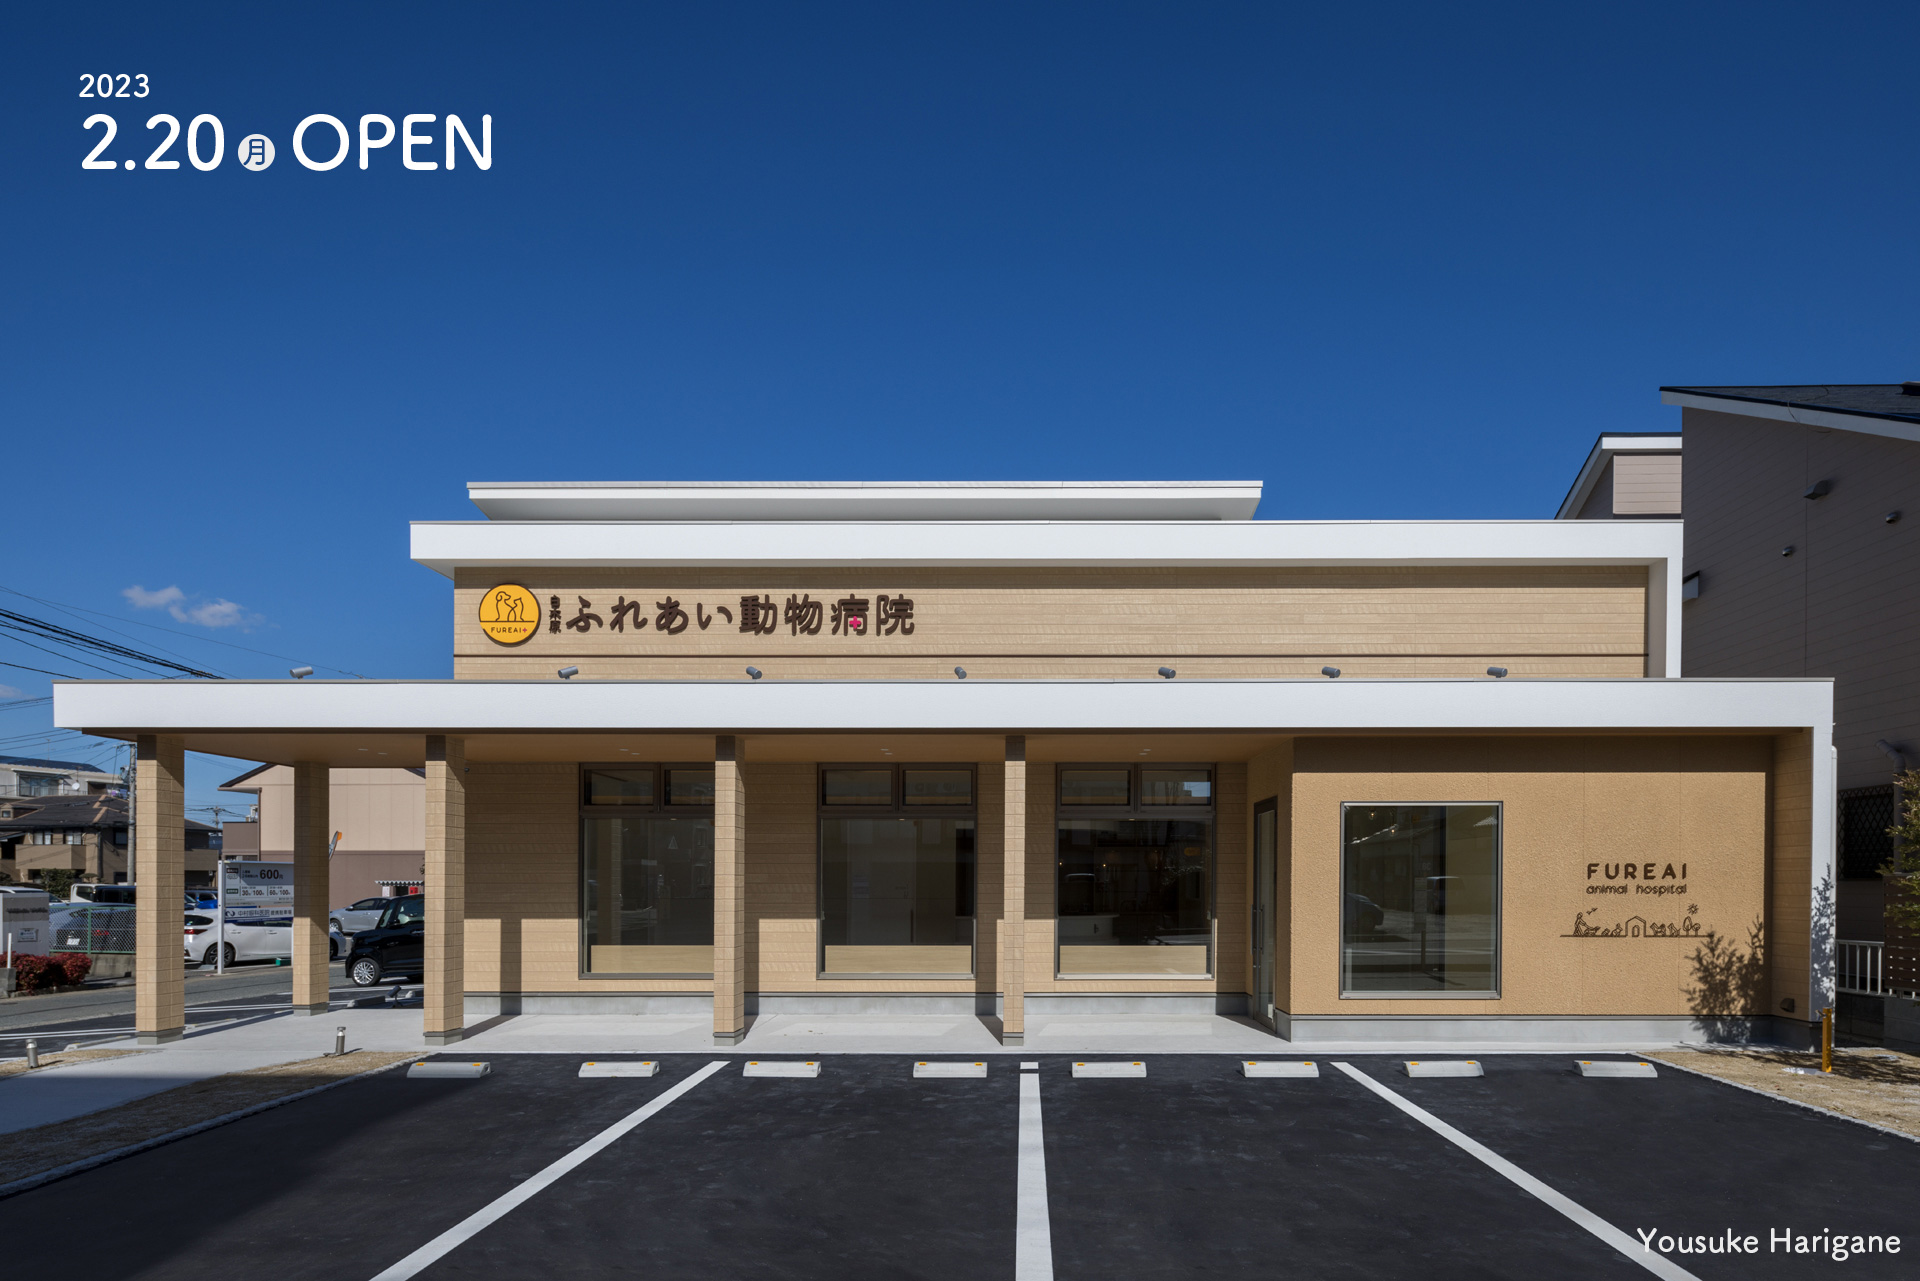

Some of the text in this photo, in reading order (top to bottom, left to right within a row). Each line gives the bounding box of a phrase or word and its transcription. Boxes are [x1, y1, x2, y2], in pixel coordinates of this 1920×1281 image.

[565, 593, 914, 637] ふれあい動物病院
[1586, 862, 1688, 880] FUREAI
[1585, 884, 1688, 897] animal hospital
